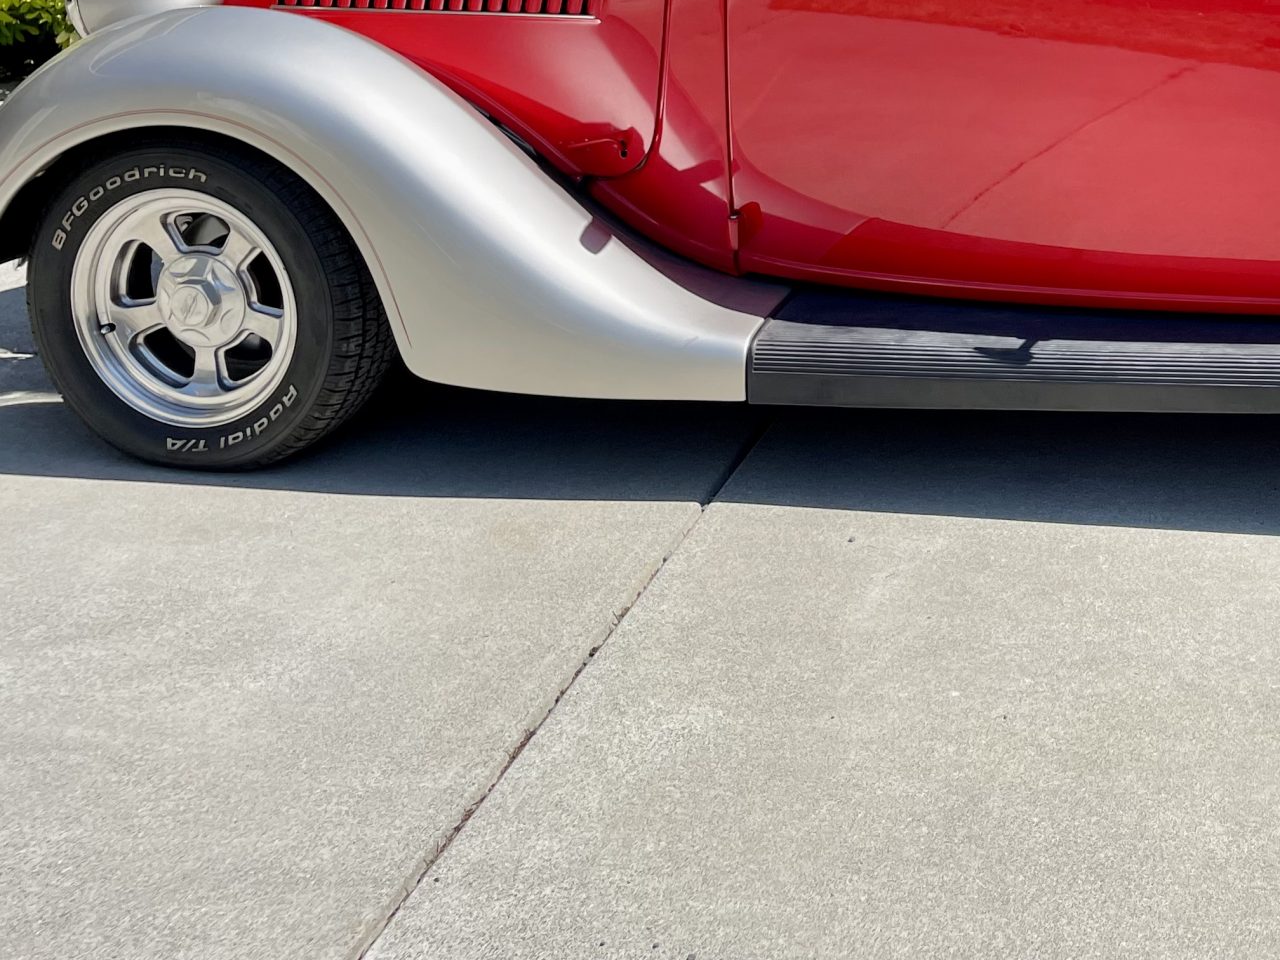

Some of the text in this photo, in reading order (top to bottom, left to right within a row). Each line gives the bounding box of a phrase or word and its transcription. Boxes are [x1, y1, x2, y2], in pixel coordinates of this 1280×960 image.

[51, 162, 208, 251] BFGoodrich
[165, 383, 298, 453] Radial T/A
